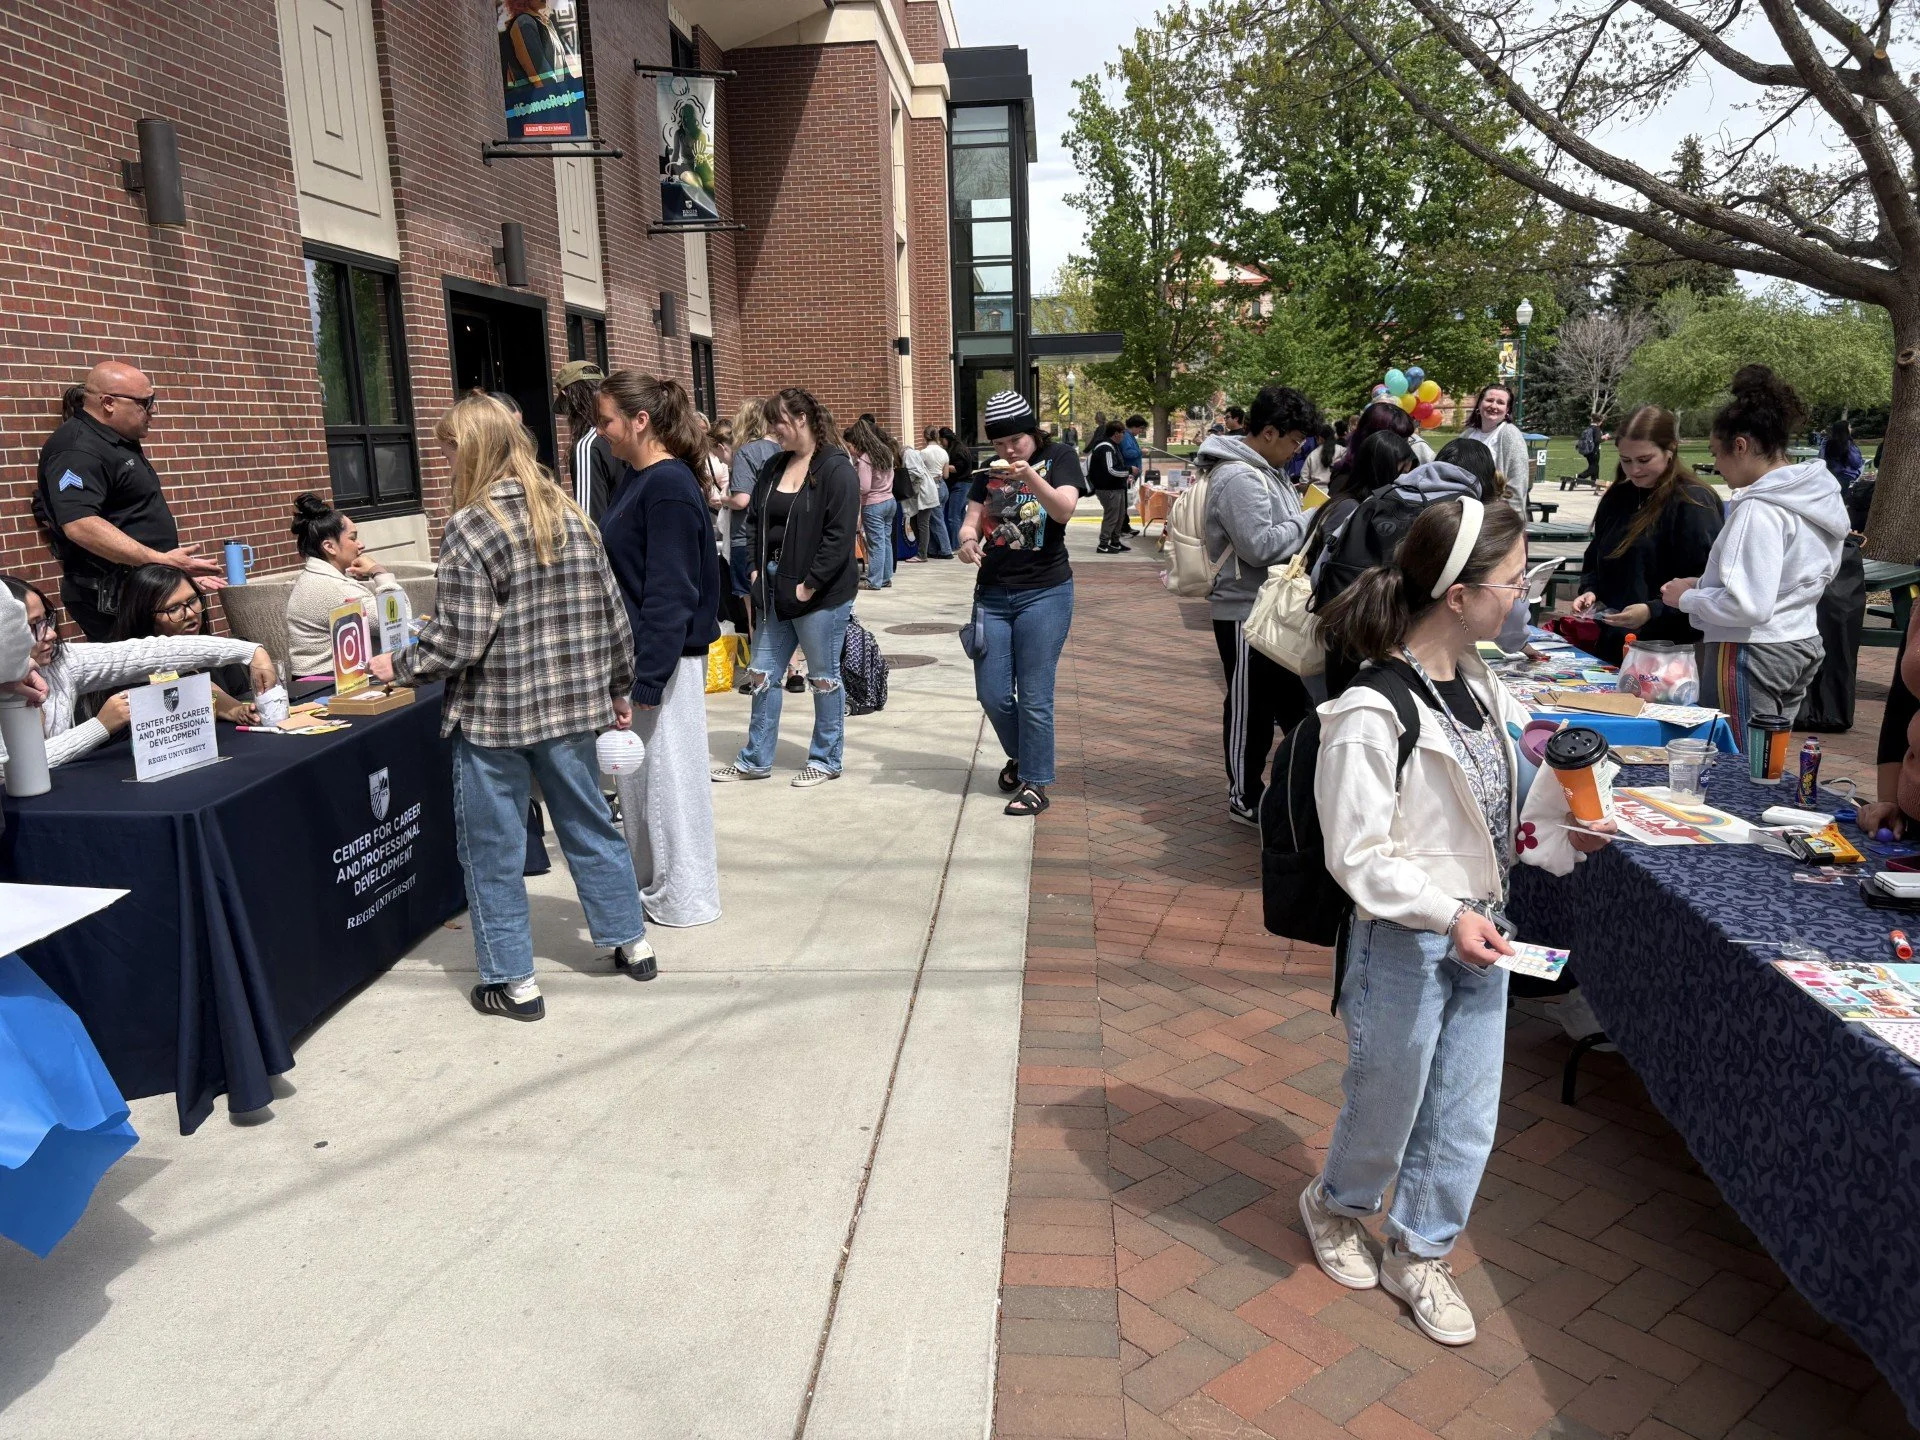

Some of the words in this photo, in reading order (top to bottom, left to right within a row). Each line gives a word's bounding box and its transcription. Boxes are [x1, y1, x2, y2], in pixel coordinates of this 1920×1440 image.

[136, 718, 164, 731] CENTER
[165, 713, 181, 723] FOR
[181, 706, 210, 719] CAREER
[139, 730, 155, 741] AND
[156, 716, 210, 736] PROFESSIONAL
[148, 754, 168, 765] REGIS
[168, 743, 206, 759] UNIVERSITY
[149, 728, 201, 748] DEVELOPMENT
[332, 832, 371, 864] CENTER
[373, 821, 392, 845] FOR
[393, 802, 421, 832] CAREER
[336, 861, 361, 884] AND
[361, 821, 421, 870] PROFESSIONAL
[354, 845, 413, 896] DEVELOPMENT
[346, 903, 375, 930] REGIS
[375, 872, 417, 913] UNIVERSITY
